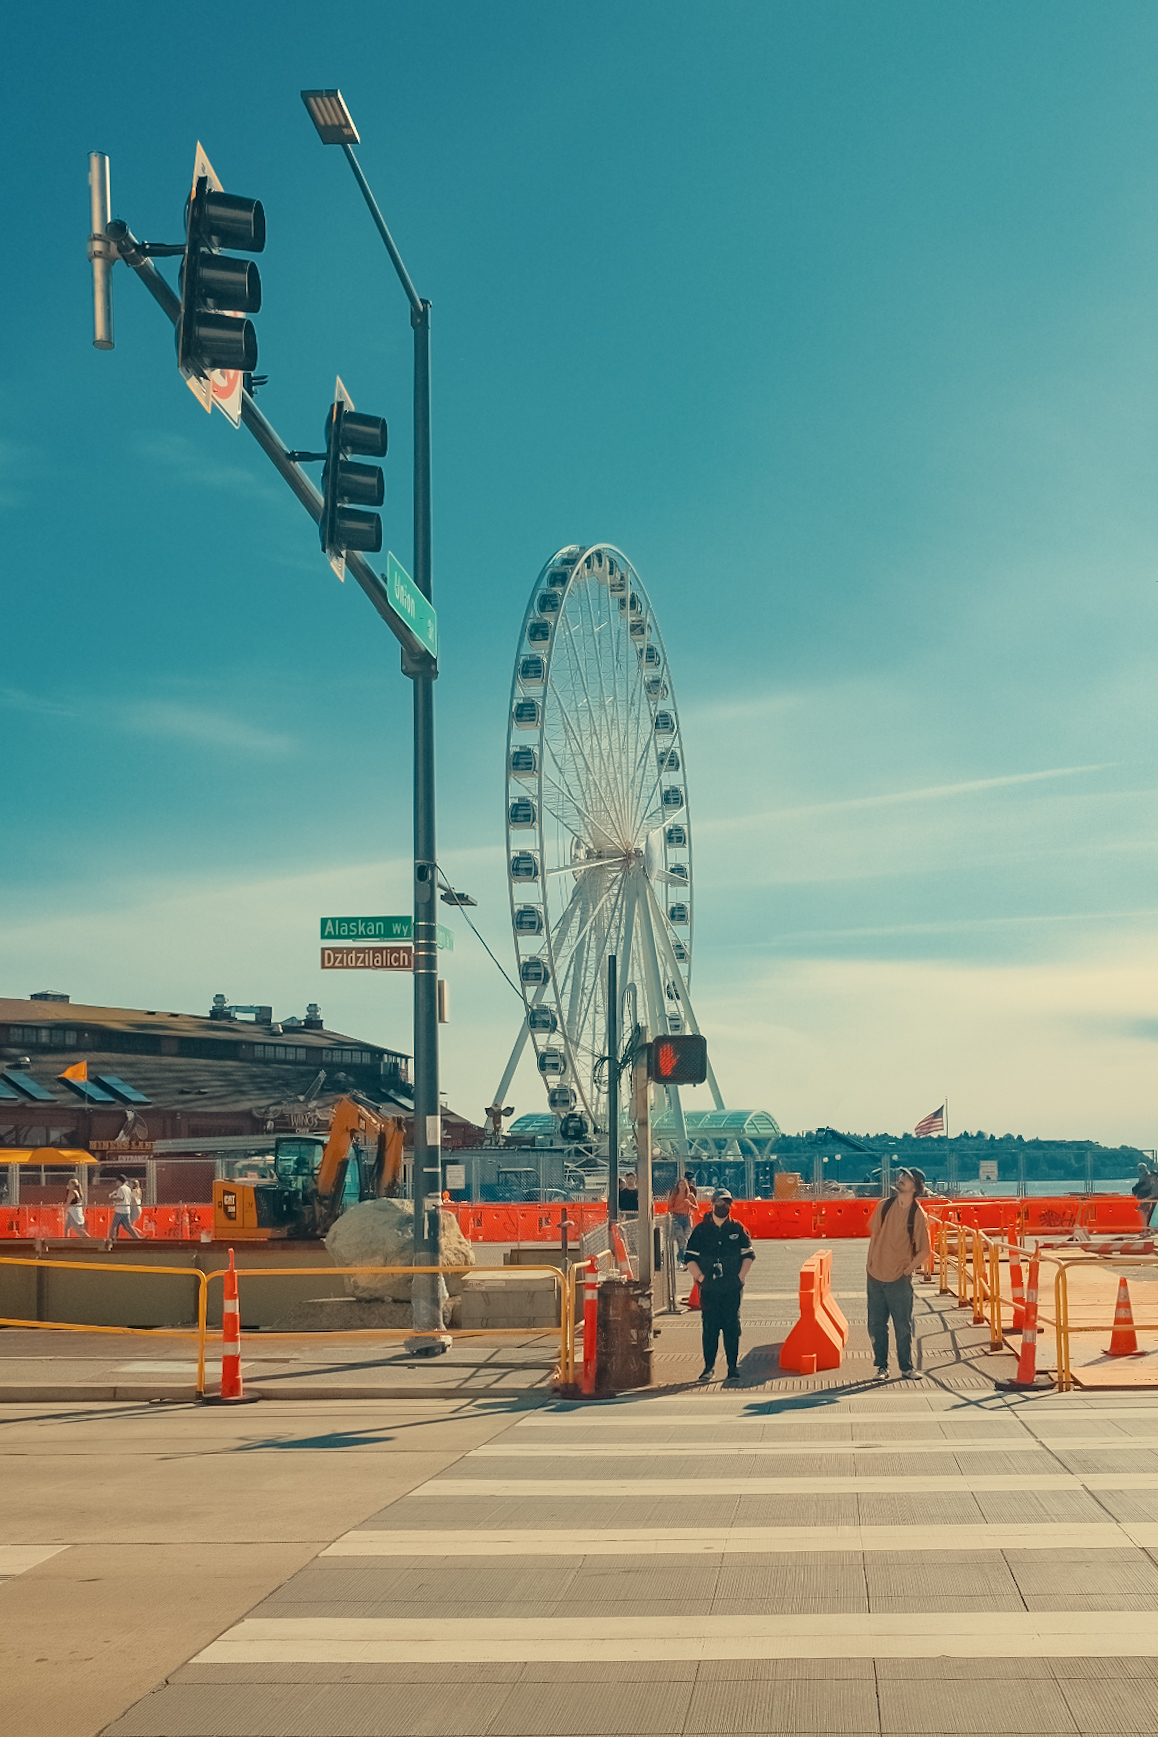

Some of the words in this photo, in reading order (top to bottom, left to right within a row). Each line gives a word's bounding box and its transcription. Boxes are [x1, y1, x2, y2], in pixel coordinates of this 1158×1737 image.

[394, 571, 416, 620] Union
[324, 919, 384, 936] Alaskan
[392, 922, 409, 937] Wy
[324, 949, 409, 967] Dzidzilalich
[223, 1194, 236, 1206] CAT
